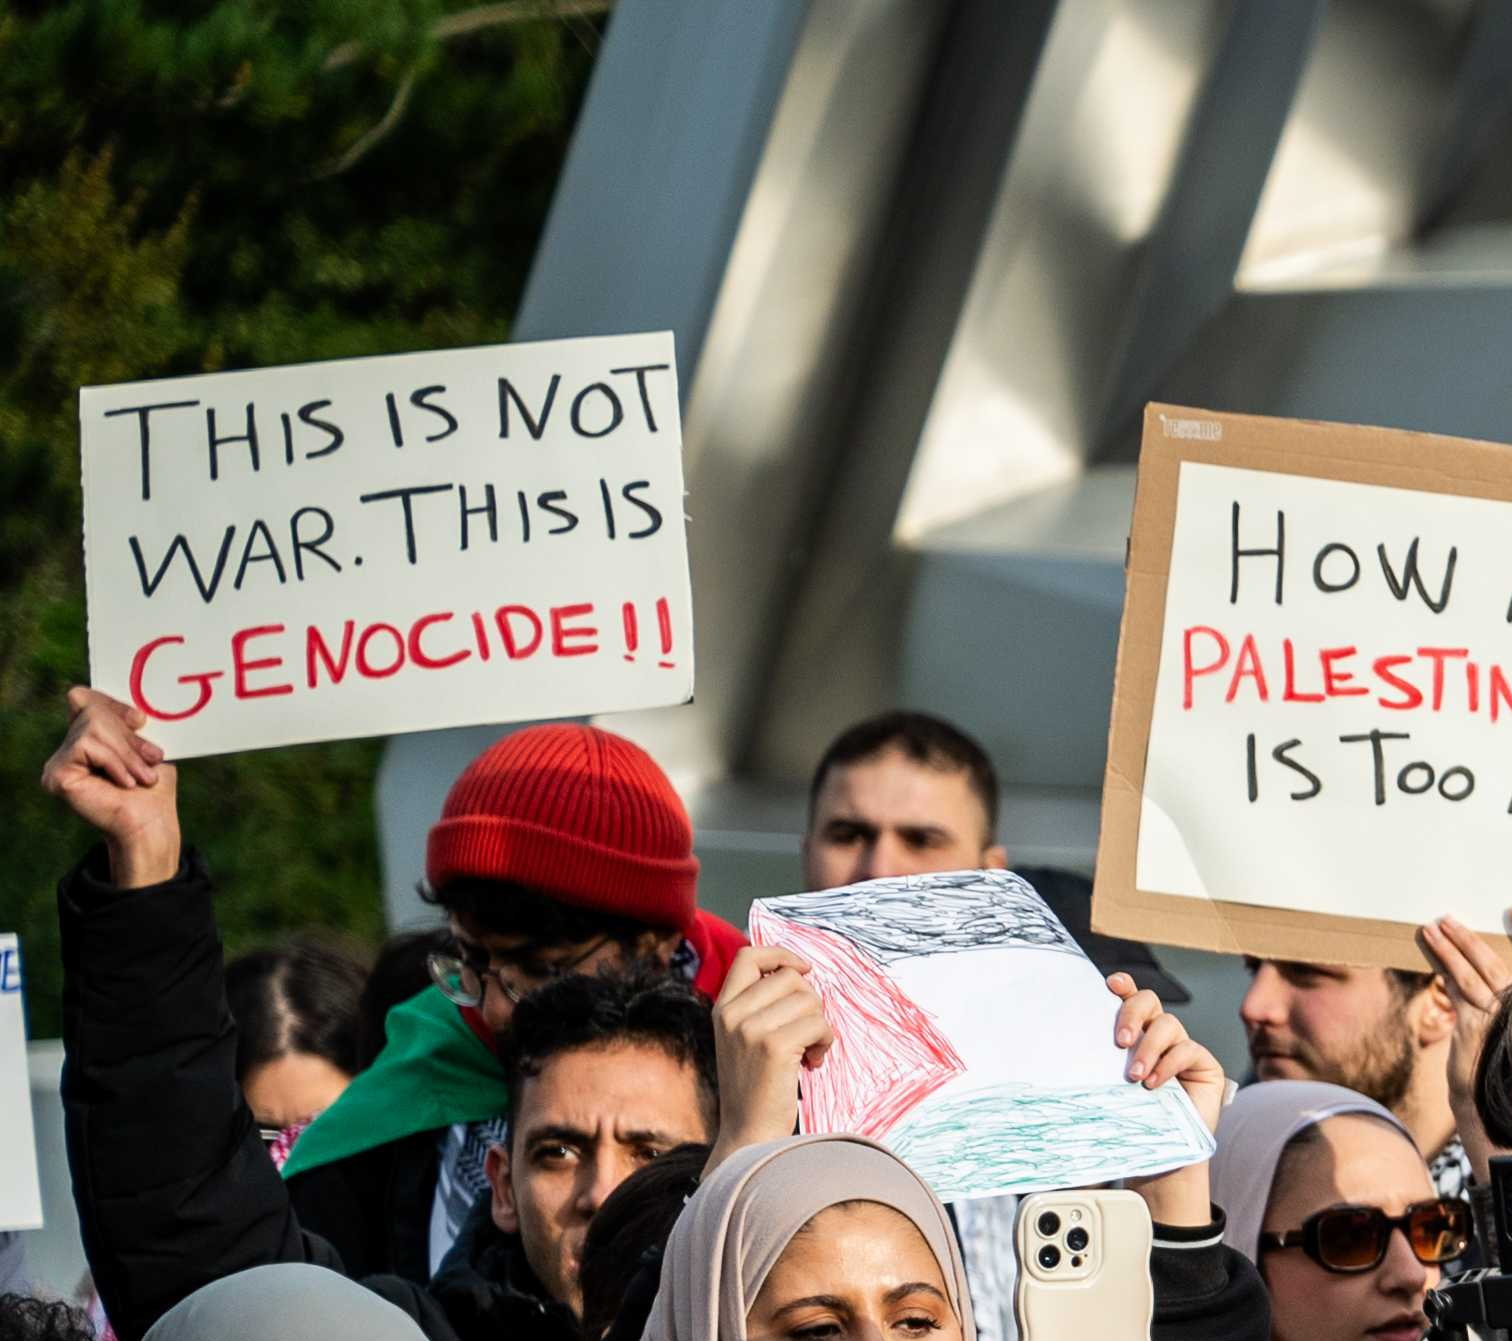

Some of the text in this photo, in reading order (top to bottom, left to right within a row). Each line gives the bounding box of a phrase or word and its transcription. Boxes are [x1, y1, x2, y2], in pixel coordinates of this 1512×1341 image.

[104, 363, 671, 501] THIS IS NOT
[128, 478, 665, 605] WAR. THIS IS
[1229, 500, 1459, 616] HOW
[1244, 731, 1323, 804] IS
